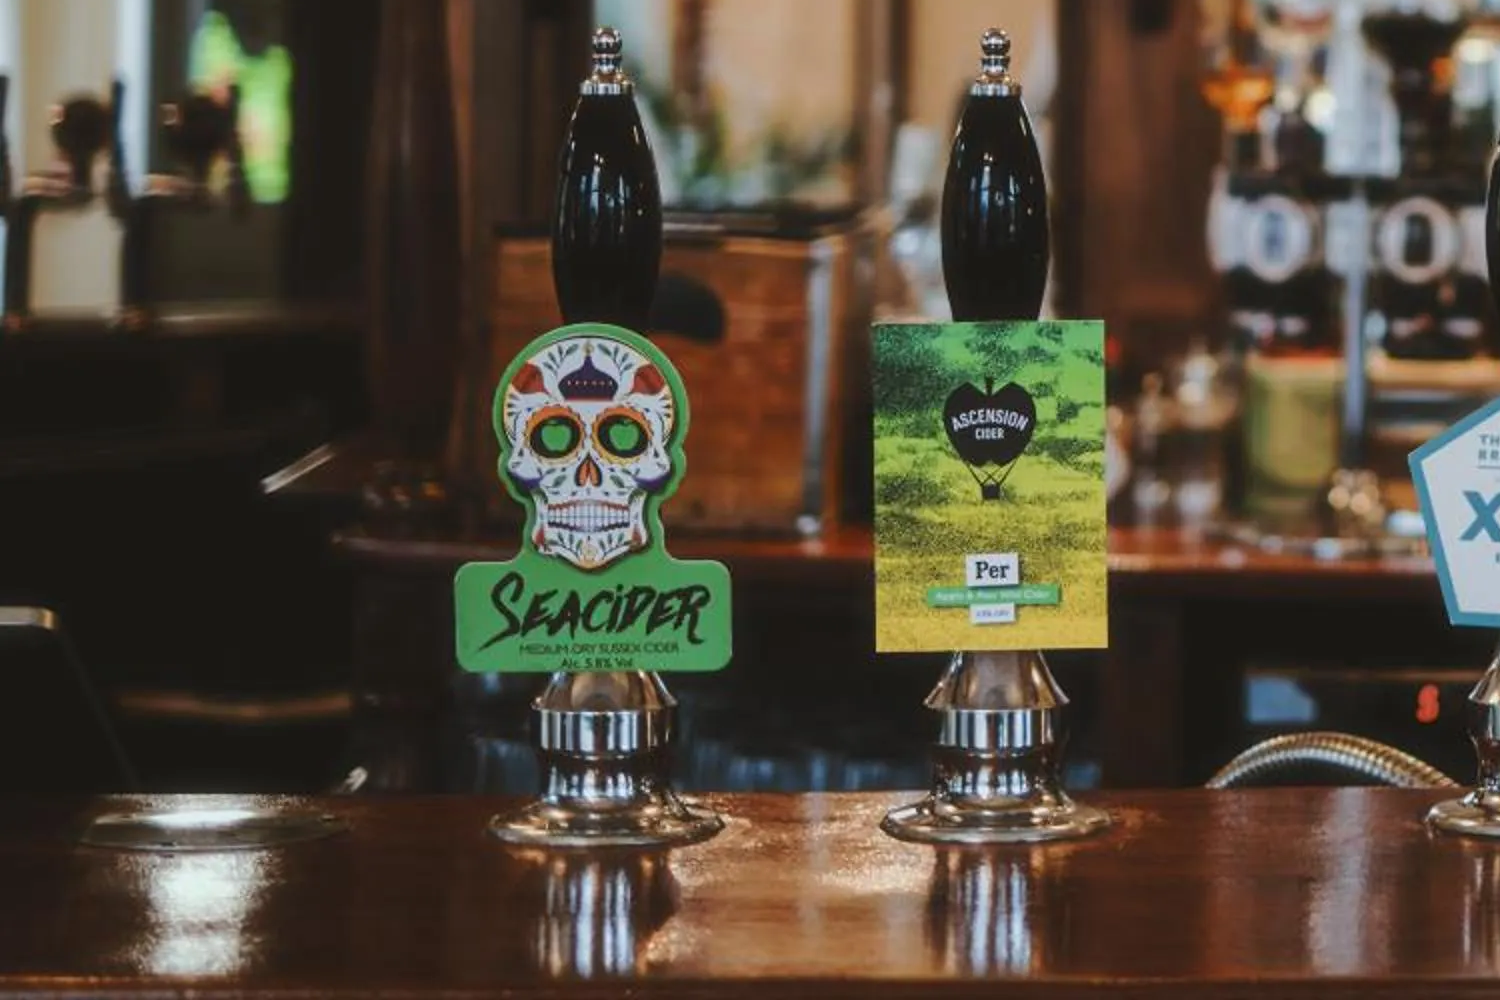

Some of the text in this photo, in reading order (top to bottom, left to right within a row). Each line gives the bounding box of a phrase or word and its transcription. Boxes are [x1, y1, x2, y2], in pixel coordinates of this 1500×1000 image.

[952, 407, 1029, 433] ASCENSION
[975, 427, 1005, 441] CIDER
[975, 561, 1010, 580] Per
